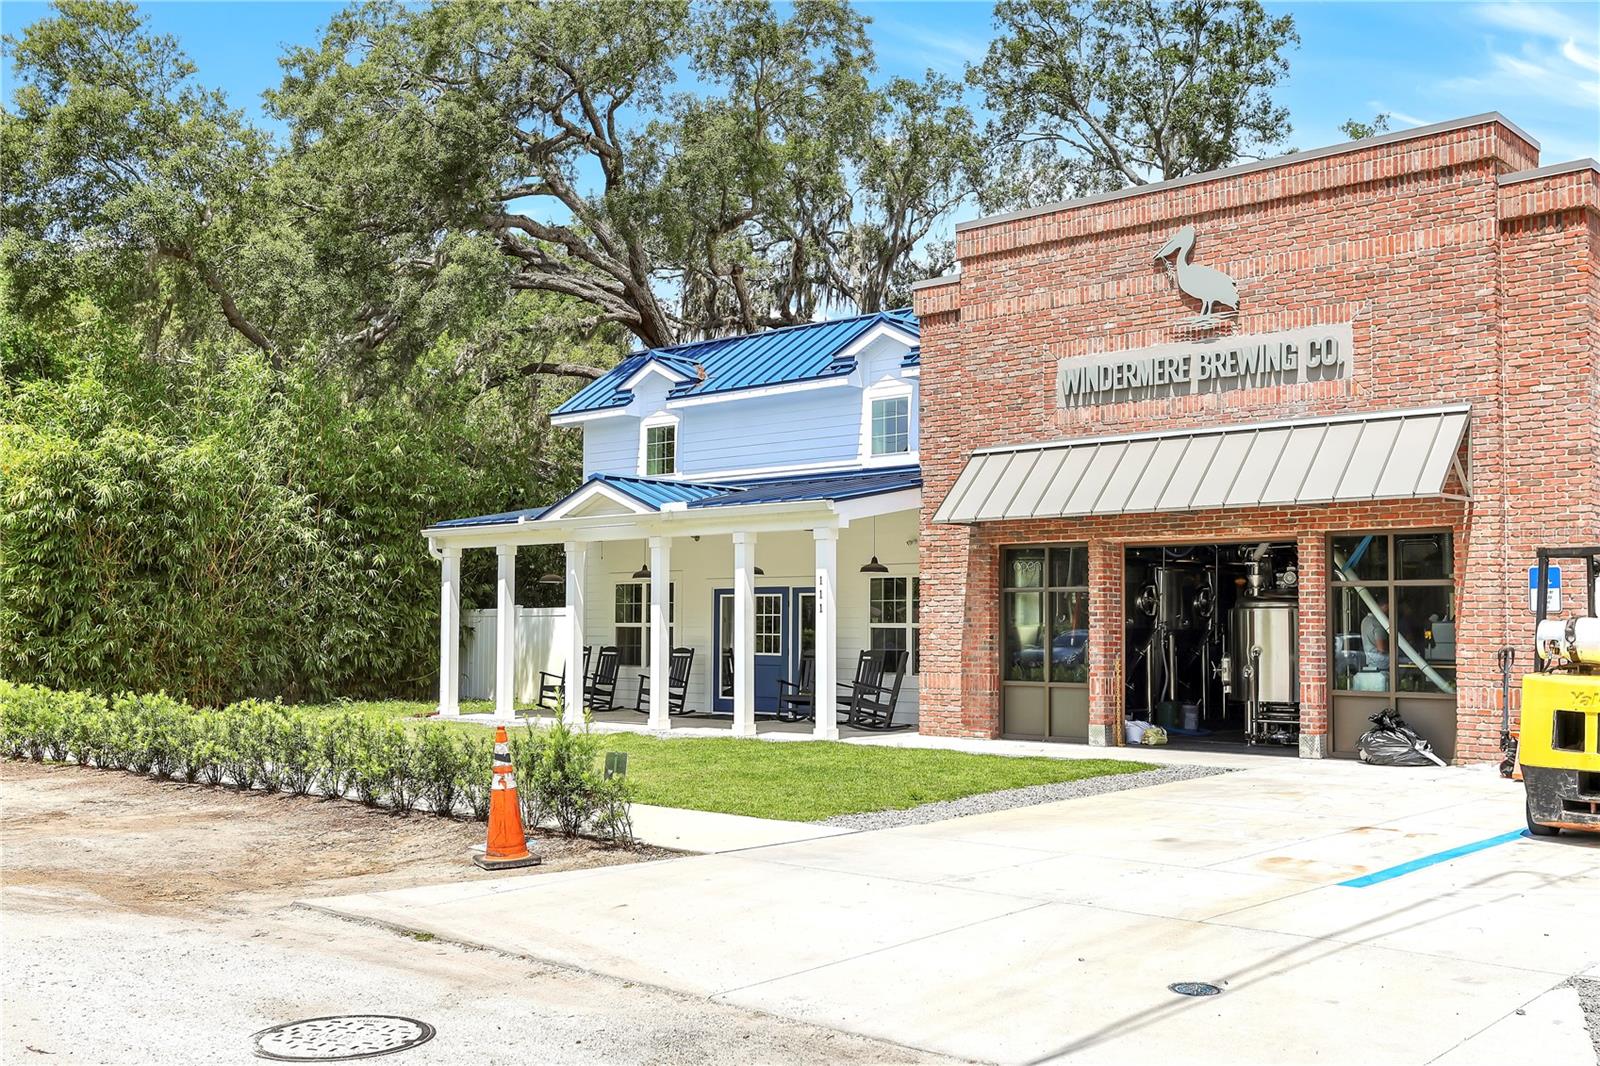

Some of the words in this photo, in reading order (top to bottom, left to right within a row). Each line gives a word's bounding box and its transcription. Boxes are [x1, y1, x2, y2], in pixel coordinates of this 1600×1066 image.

[1062, 354, 1192, 396] WINDERMERE
[1198, 343, 1298, 380] BREWING
[1306, 337, 1344, 368] CO.
[1570, 691, 1600, 706] Yal
